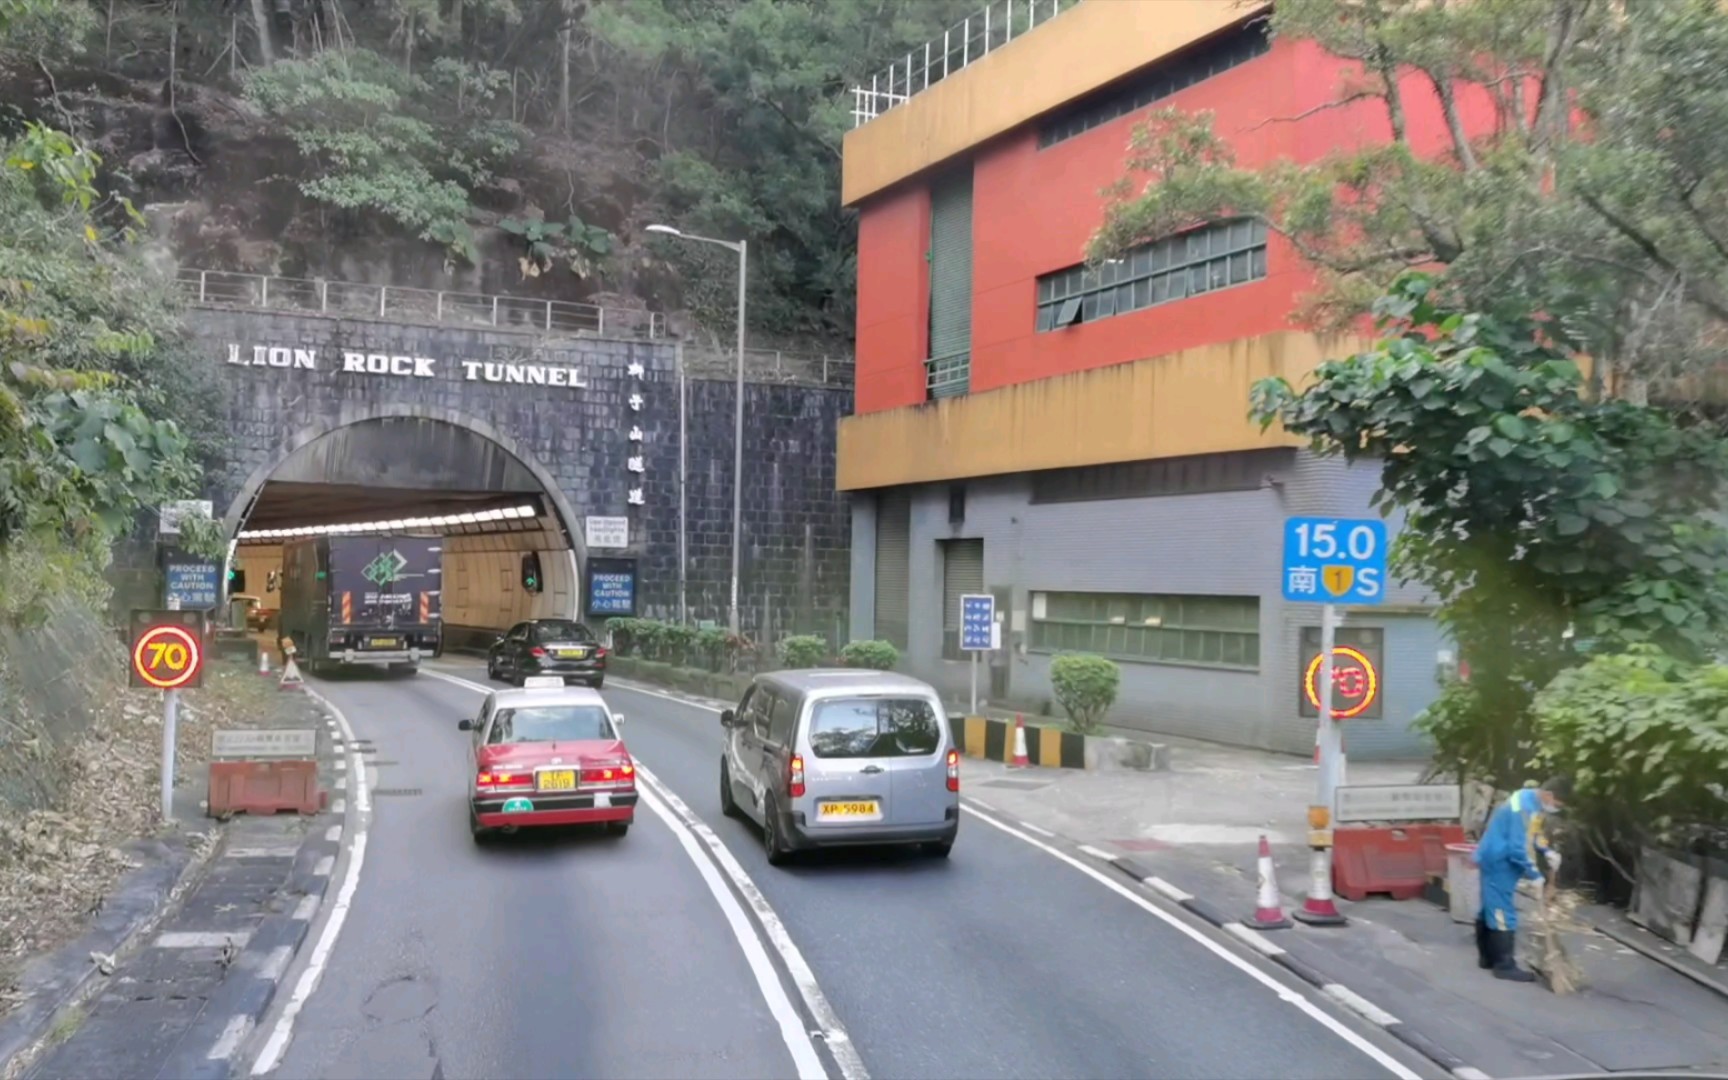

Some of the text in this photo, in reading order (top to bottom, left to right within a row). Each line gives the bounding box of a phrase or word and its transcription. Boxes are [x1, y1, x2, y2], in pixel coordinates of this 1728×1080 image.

[228, 343, 588, 389] LION ROCK TUNNEL
[1294, 522, 1376, 560] 15.0
[169, 564, 216, 573] PROCEED
[181, 573, 205, 581] WITH
[592, 574, 631, 582] PROCEED
[1287, 565, 1380, 597] 南 1 S
[170, 581, 214, 590] CAUTION
[593, 590, 630, 598] CAUTION
[147, 642, 188, 670] 70
[822, 803, 875, 815] XP 5984
